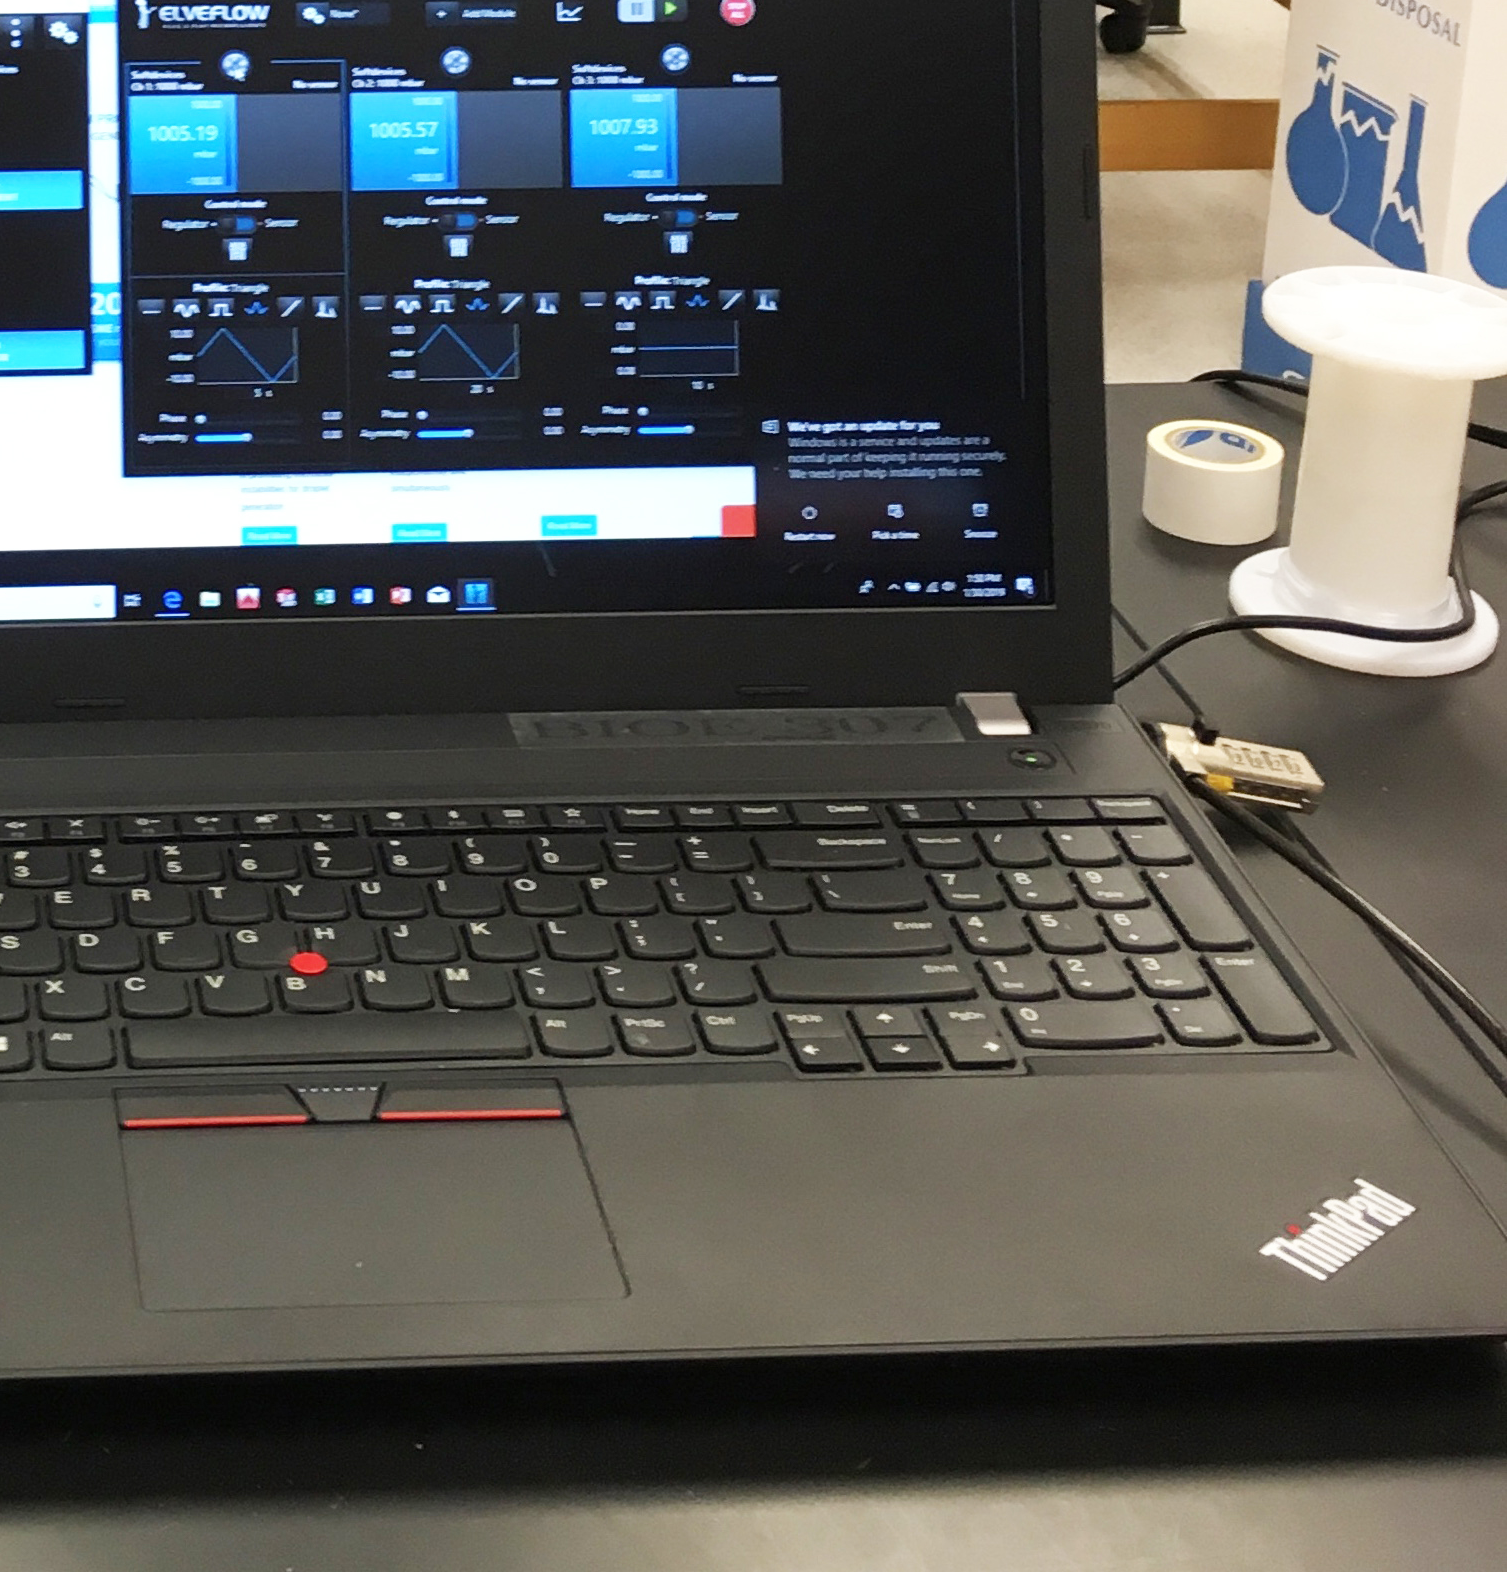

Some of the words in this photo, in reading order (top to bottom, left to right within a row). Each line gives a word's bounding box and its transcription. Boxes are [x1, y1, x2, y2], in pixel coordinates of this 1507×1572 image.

[158, 4, 271, 22] ELVEFLOW
[588, 118, 659, 135] 1007.93
[147, 125, 219, 142] 1005.19
[317, 856, 332, 868] 7
[392, 855, 409, 867] 8
[467, 852, 485, 865] 9
[542, 851, 560, 864] 0
[13, 865, 30, 878] 3
[91, 864, 106, 875] 4
[166, 861, 183, 873] 5
[240, 859, 258, 871] 6
[360, 881, 381, 894] U
[437, 879, 448, 892] I
[514, 878, 538, 892] O
[589, 877, 608, 890] P
[130, 888, 151, 901] R
[207, 886, 227, 899] T
[284, 884, 304, 897] Y
[53, 891, 74, 904] E
[313, 927, 336, 940] H
[394, 924, 409, 938] J
[469, 922, 492, 936] K
[547, 921, 567, 935] L
[0, 935, 20, 949] S
[78, 934, 100, 947] D
[156, 931, 175, 945] F
[236, 929, 259, 944] G
[1066, 959, 1086, 973] 2
[1141, 957, 1161, 971] 3
[364, 970, 387, 983] N
[445, 968, 470, 981] M
[45, 980, 65, 994] X
[124, 977, 146, 991] C
[204, 975, 225, 989] V
[286, 977, 307, 990] B
[1258, 1177, 1417, 1281] ThinkPad
